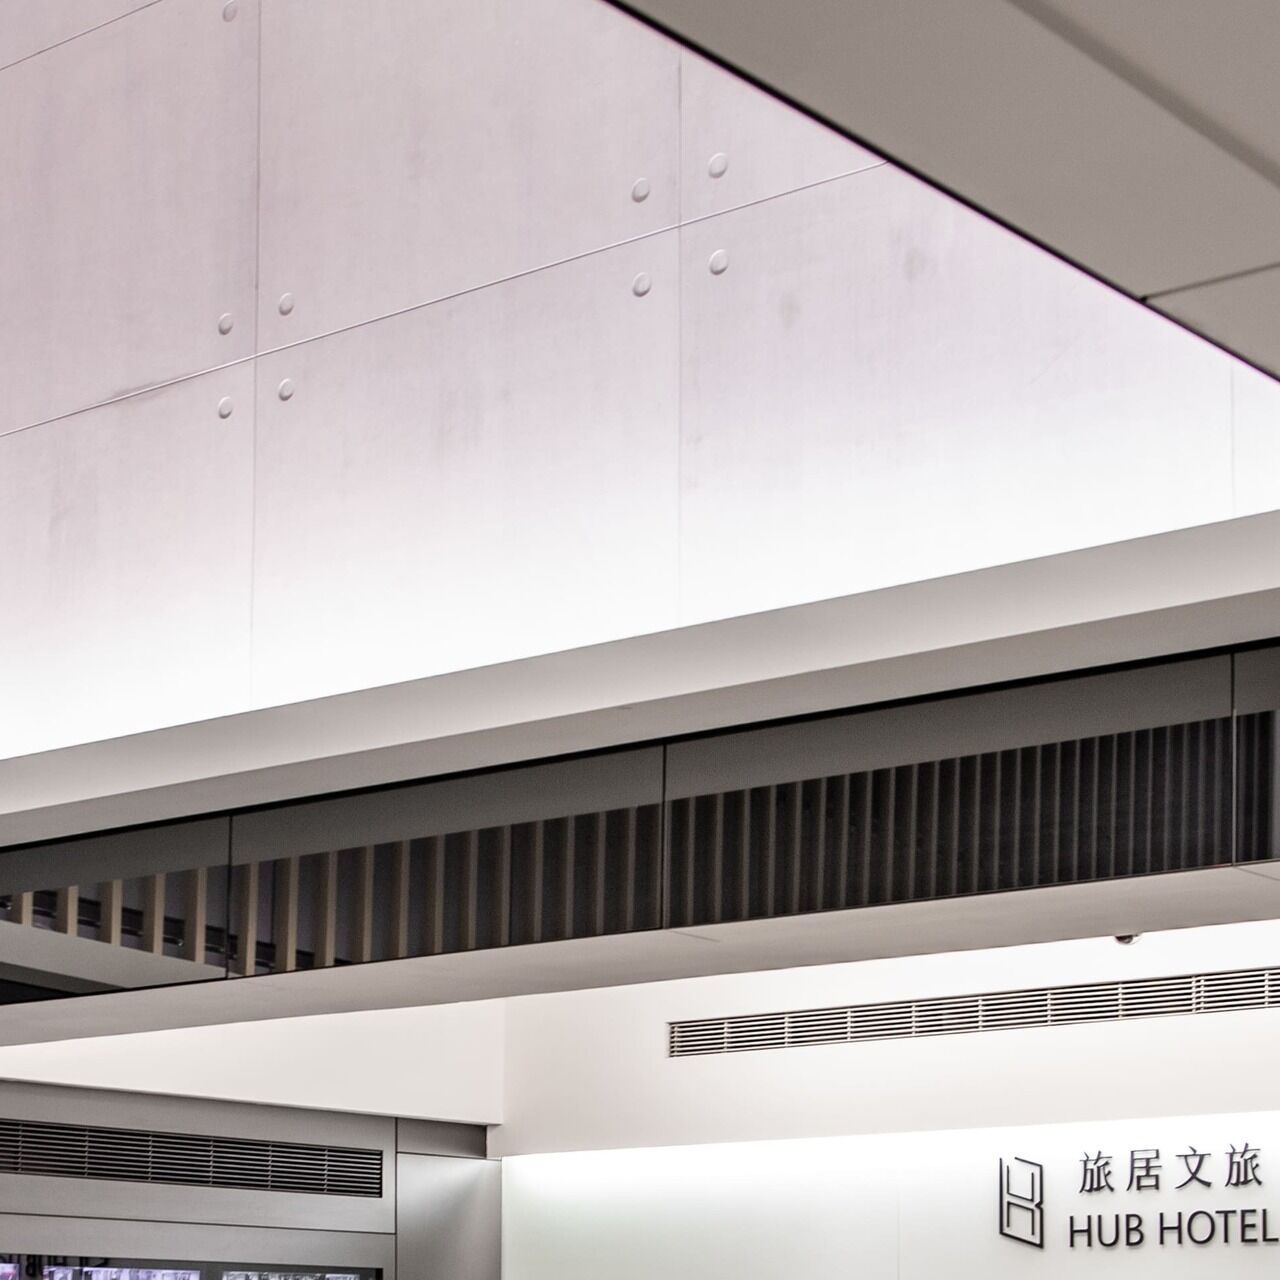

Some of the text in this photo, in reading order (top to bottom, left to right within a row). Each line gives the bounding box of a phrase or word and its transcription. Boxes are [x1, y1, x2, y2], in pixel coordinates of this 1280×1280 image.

[1079, 1143, 1262, 1193] 旅居文旅
[1069, 1208, 1280, 1248] HUB HOTEL
